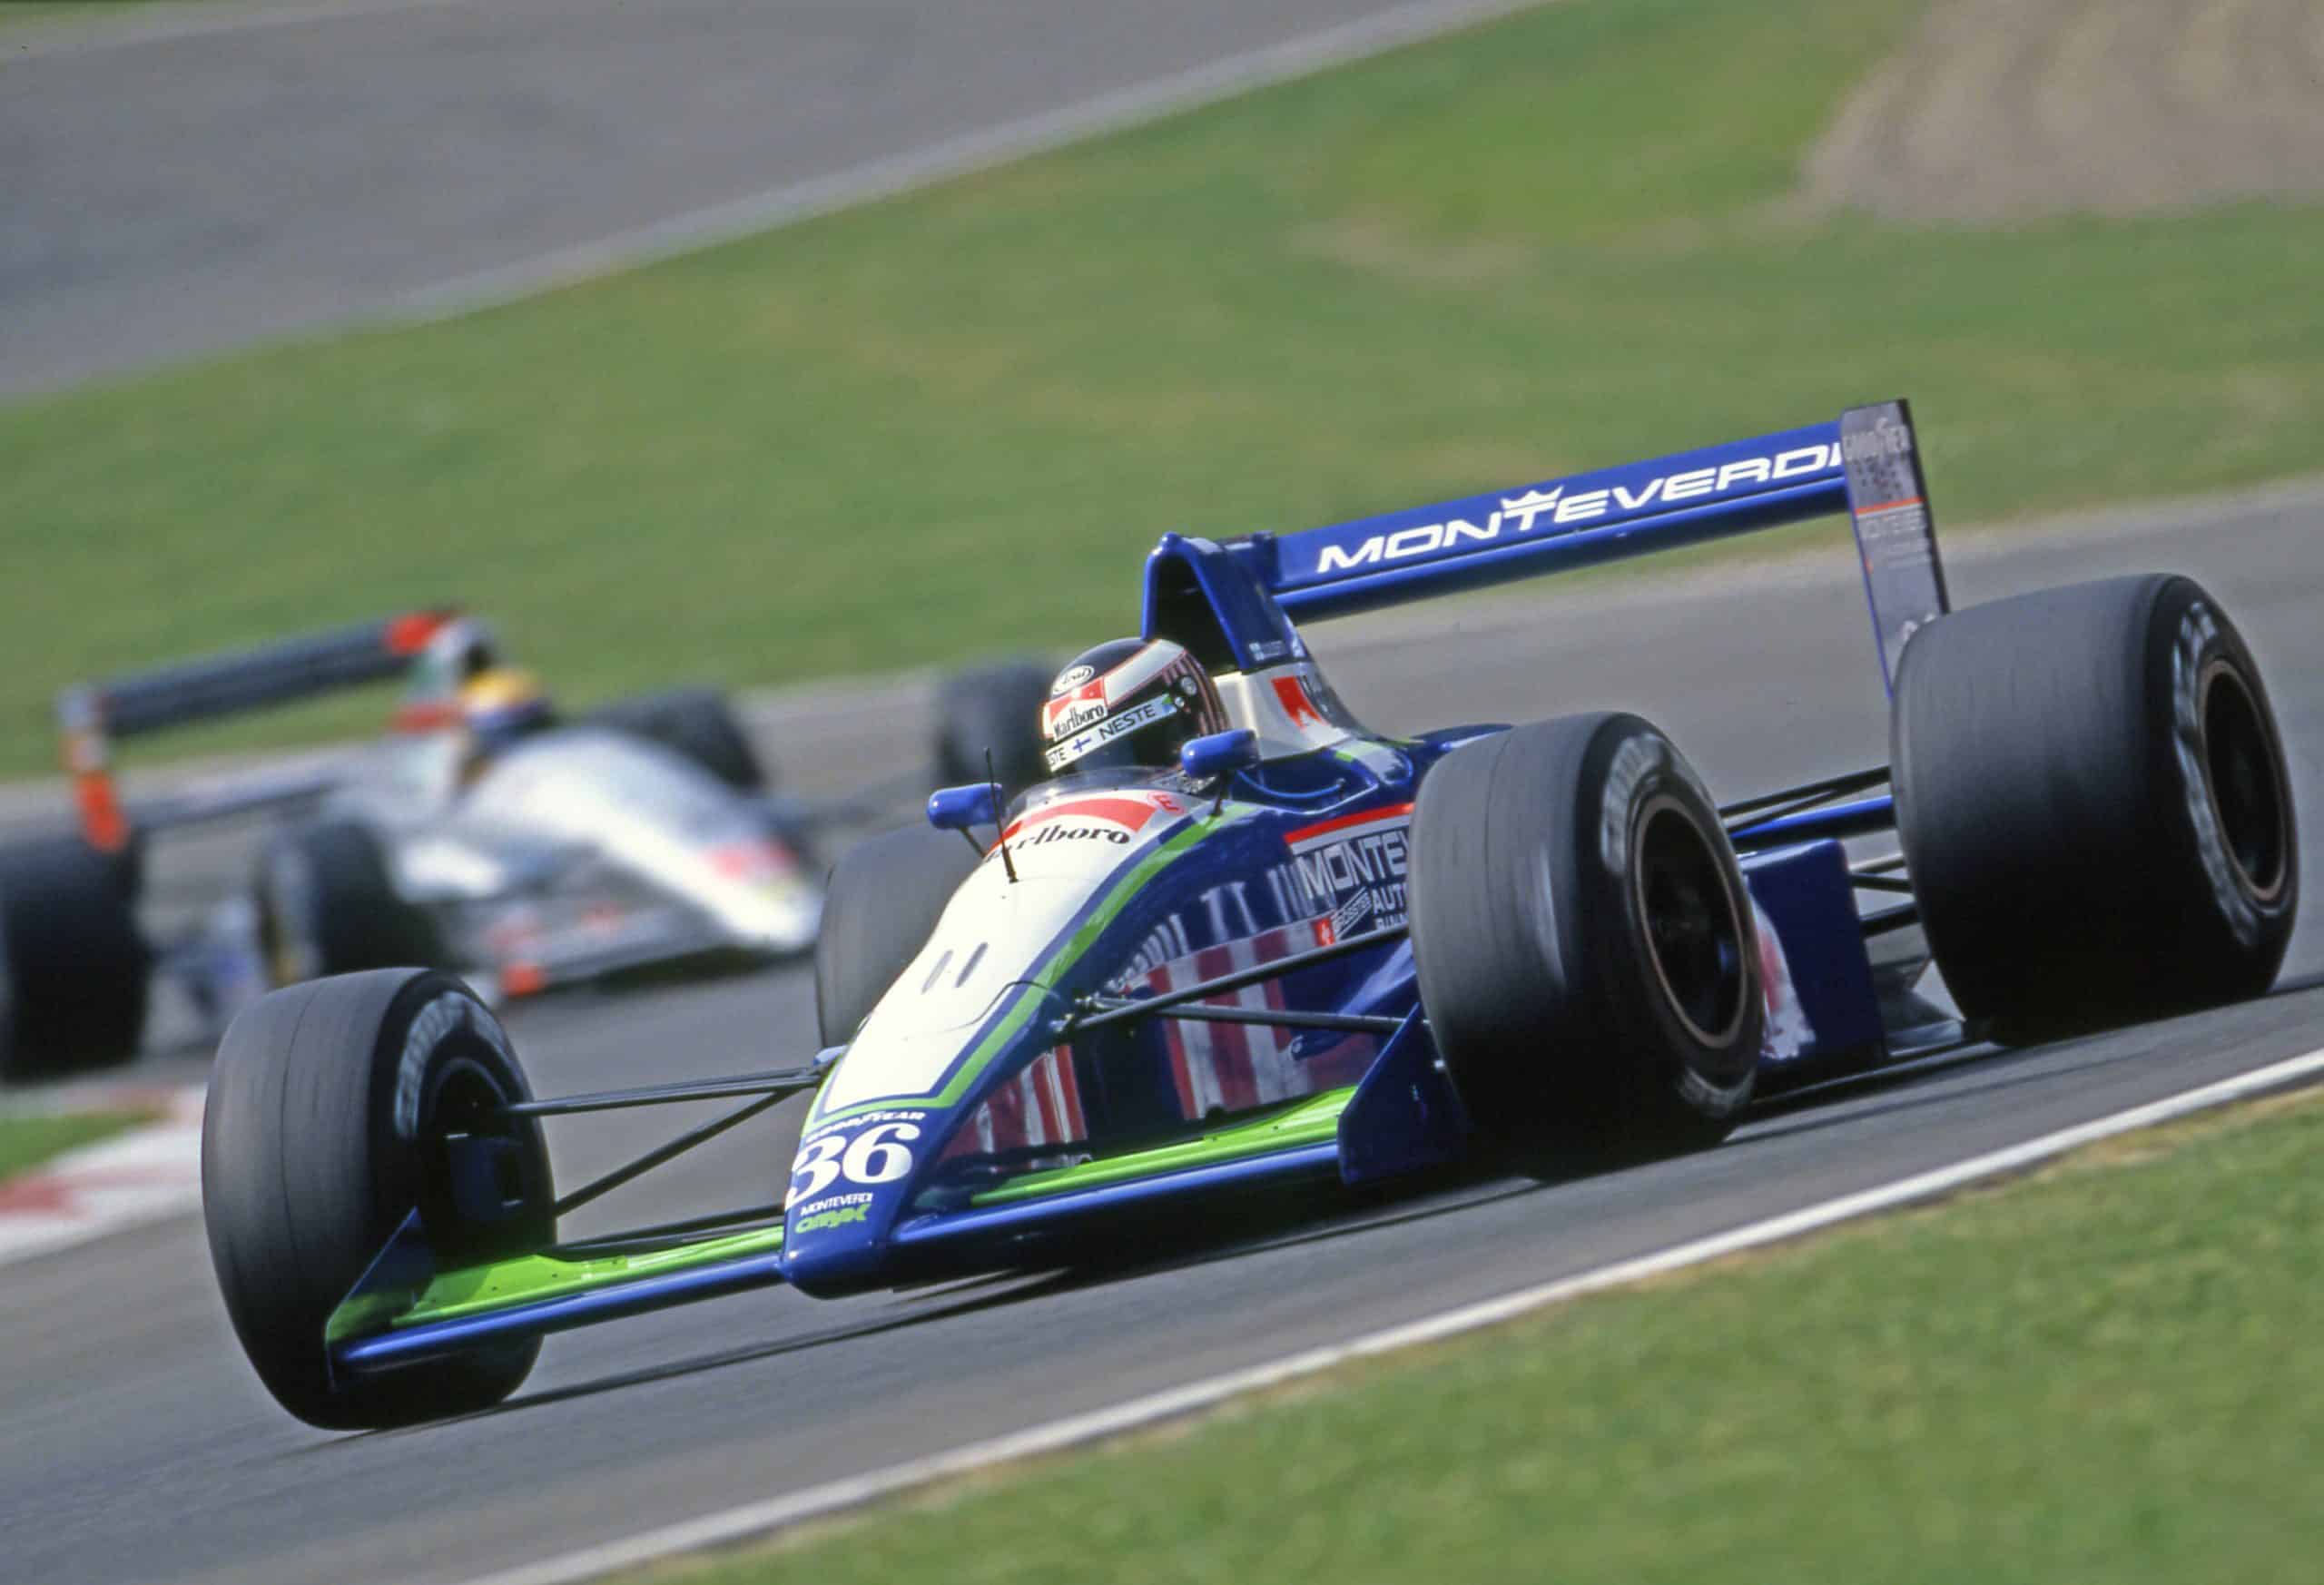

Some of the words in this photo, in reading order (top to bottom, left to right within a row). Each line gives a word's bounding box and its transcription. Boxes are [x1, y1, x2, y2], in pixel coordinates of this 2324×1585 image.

[1054, 704, 1105, 737] Marlboro
[1098, 704, 1156, 741] NESTE
[784, 1122, 921, 1211] 36
